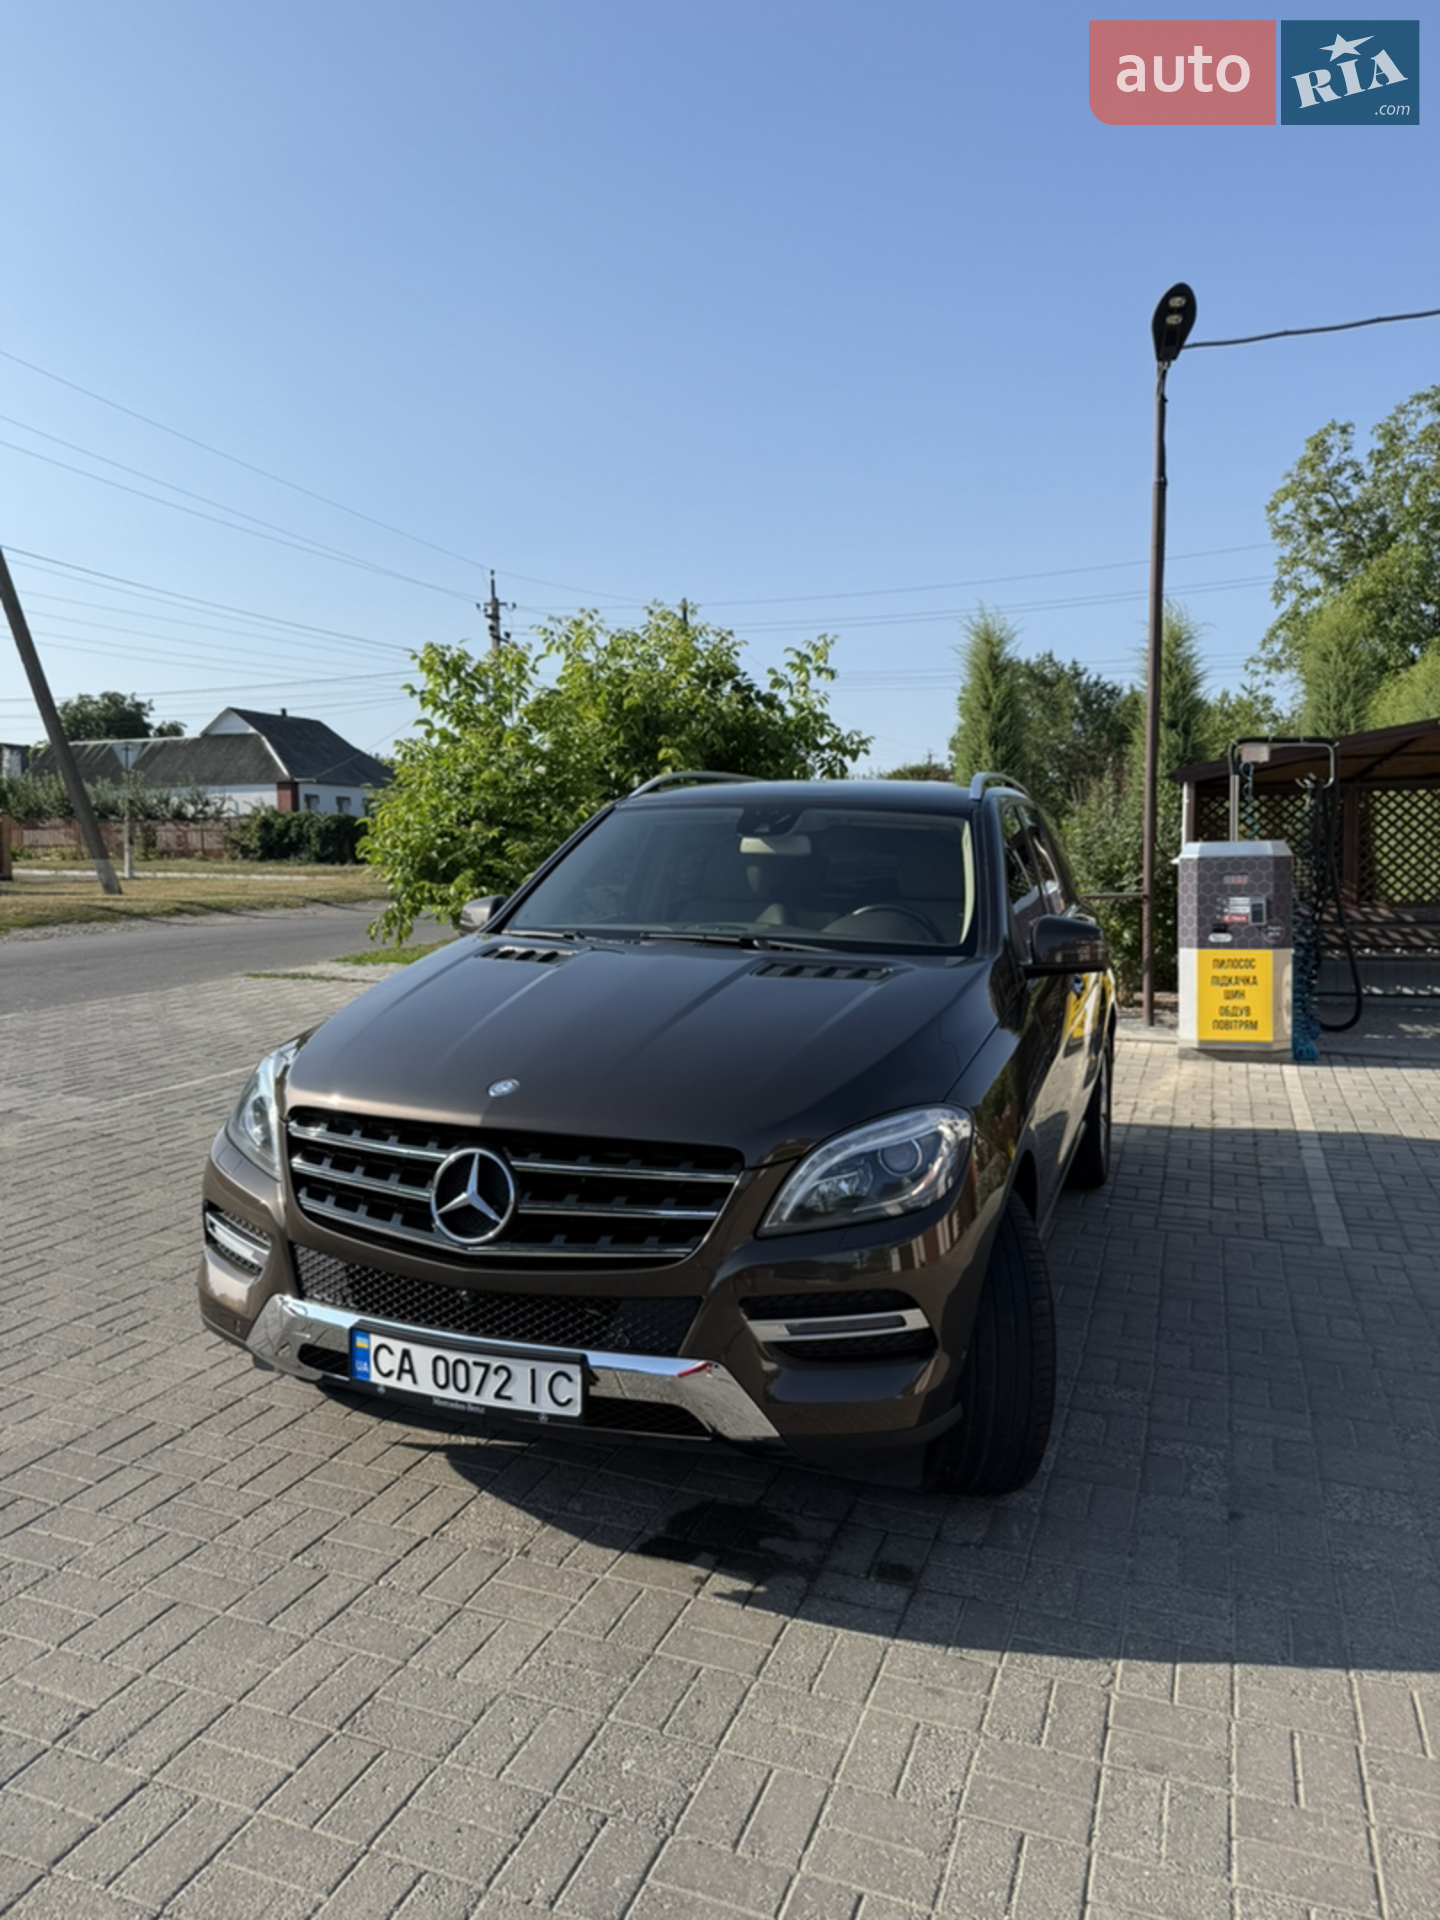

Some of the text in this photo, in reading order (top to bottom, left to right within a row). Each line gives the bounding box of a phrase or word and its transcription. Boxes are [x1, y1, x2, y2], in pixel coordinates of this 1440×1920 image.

[1212, 958, 1257, 970] ПИЛОСОС
[1210, 975, 1258, 988] ПІДКАЧКА
[1223, 989, 1246, 1000] ШИН
[1219, 1006, 1251, 1018] ОБДУВ
[1212, 1020, 1258, 1032] ПОВІТРЯМ
[372, 1343, 574, 1407] CA 0072 IC
